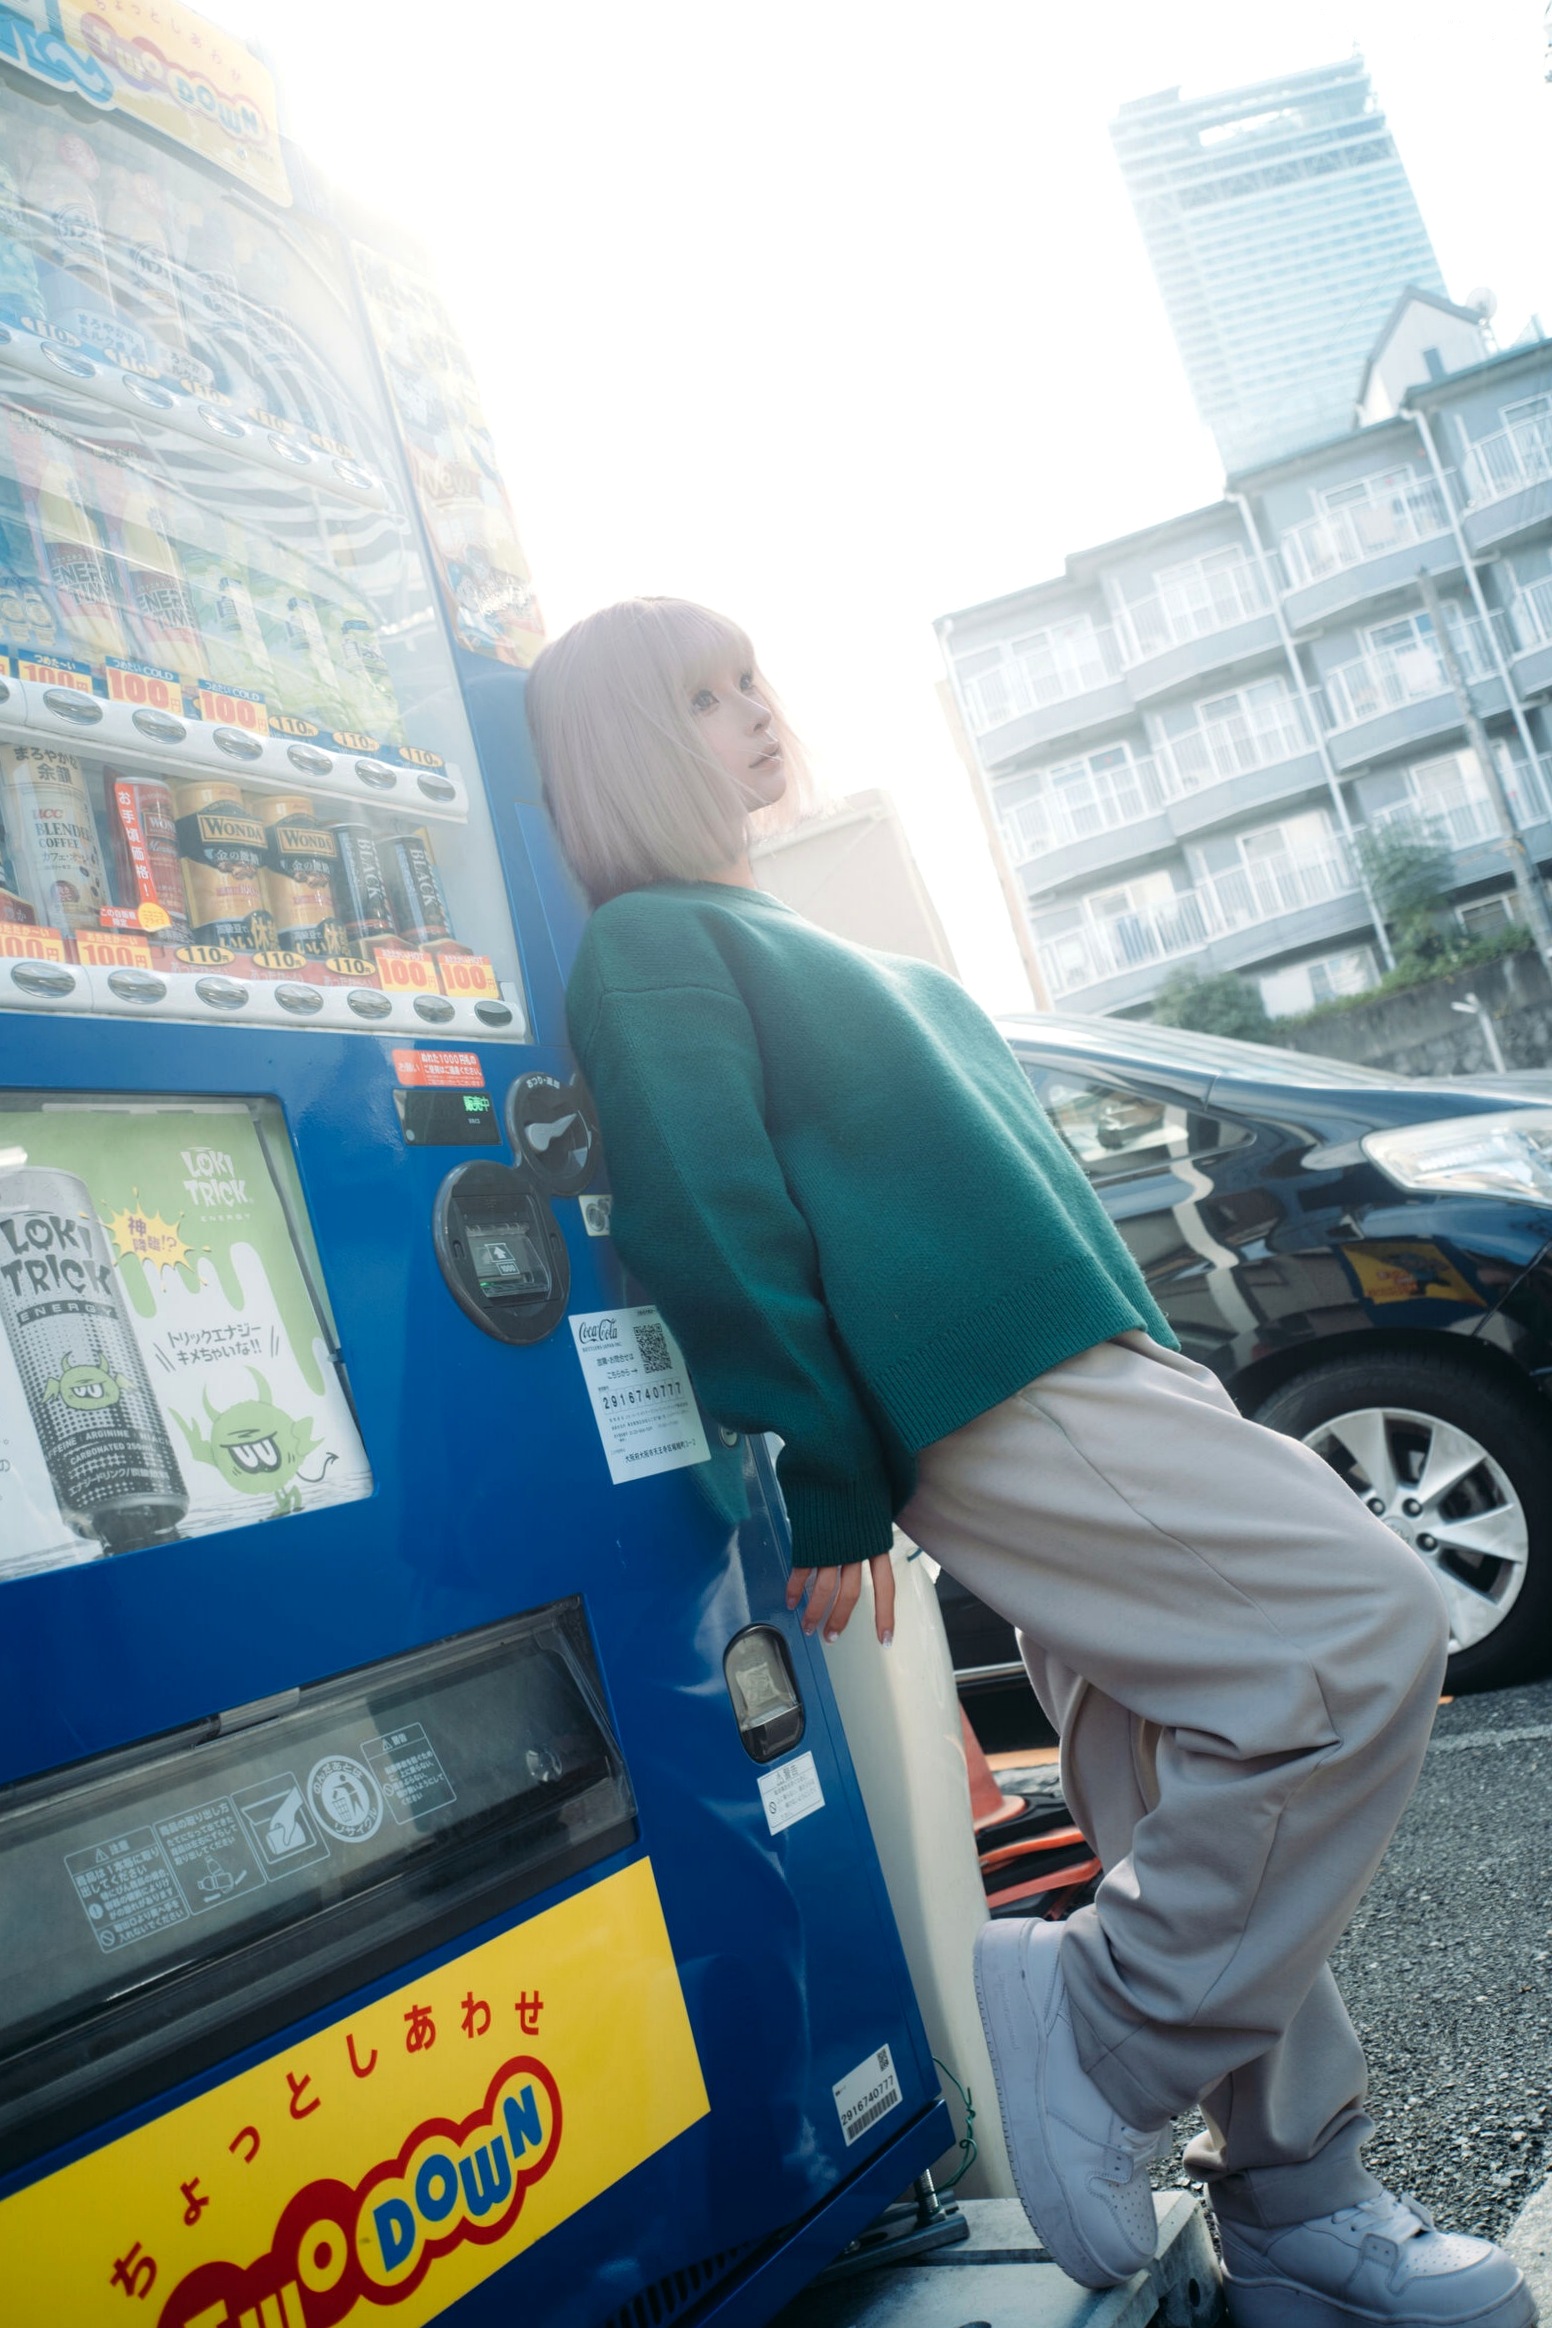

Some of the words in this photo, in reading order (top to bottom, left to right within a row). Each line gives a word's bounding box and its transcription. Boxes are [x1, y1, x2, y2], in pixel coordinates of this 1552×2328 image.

[142, 665, 175, 681] COLD
[107, 667, 182, 714] 100円
[232, 687, 261, 702] COLD
[39, 837, 81, 849] COFFEE
[202, 816, 264, 842] WONDA
[356, 837, 384, 900] BLACK
[408, 848, 438, 907] BLACK
[462, 1095, 490, 1112] 販売中
[180, 1147, 236, 1179] LOKI
[183, 1178, 250, 1208] TRICK
[1, 1215, 94, 1259] LOKI
[127, 1215, 147, 1238] 神
[1, 1255, 112, 1298] TRICK
[18, 1300, 114, 1324] ENERGY
[167, 1322, 262, 1349] トリックエナジー
[602, 1381, 683, 1410] 2916740777
[85, 1428, 130, 1440] ARGININE
[69, 1442, 126, 1466] CARBONATED
[313, 1760, 365, 1795] のんだあとは
[334, 1806, 377, 1836] リサイクル
[80, 1864, 148, 1898] 出してください
[118, 1908, 185, 1944] 入れないでください
[839, 2073, 894, 2126] 2916740777
[109, 1990, 545, 2300] ちょっとしあわせ
[372, 2084, 543, 2273] DOWN
